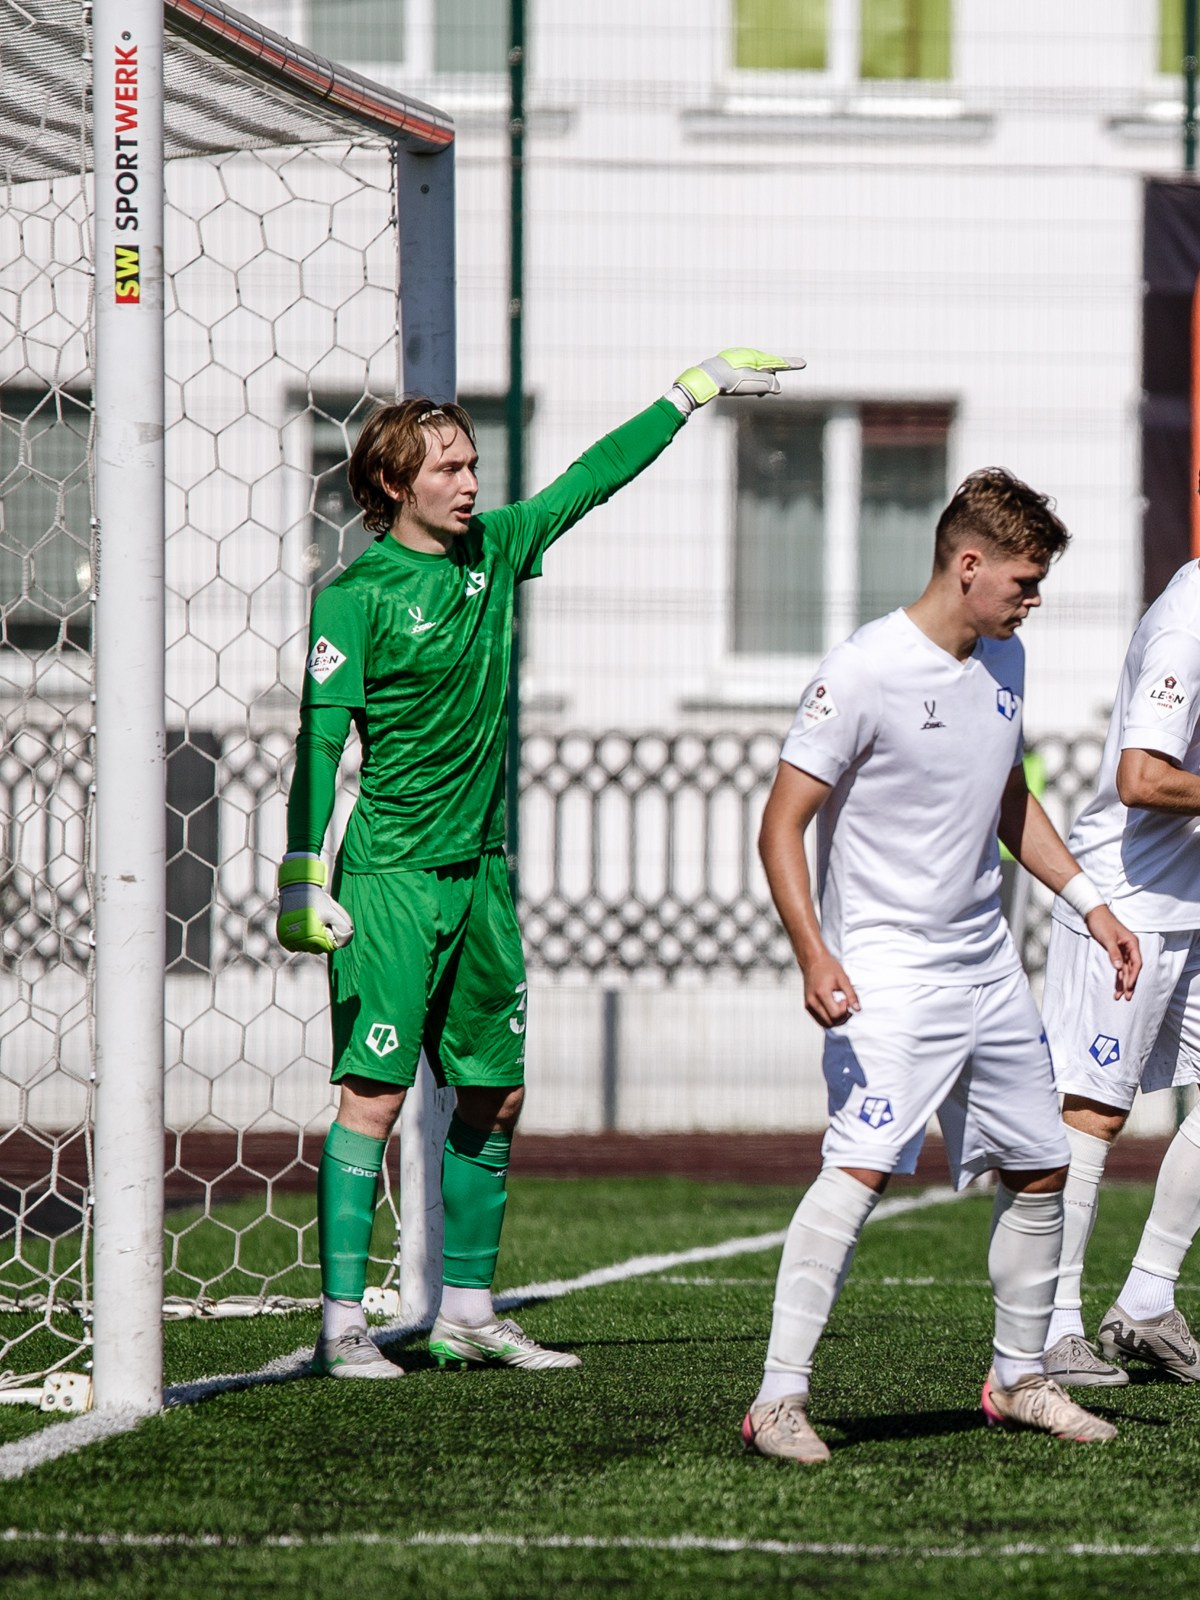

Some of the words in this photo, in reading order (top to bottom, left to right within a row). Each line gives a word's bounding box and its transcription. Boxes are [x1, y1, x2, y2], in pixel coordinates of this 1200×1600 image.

[114, 45, 138, 231] SPORTWERK
[115, 246, 140, 299] SW
[1150, 690, 1185, 704] LEON
